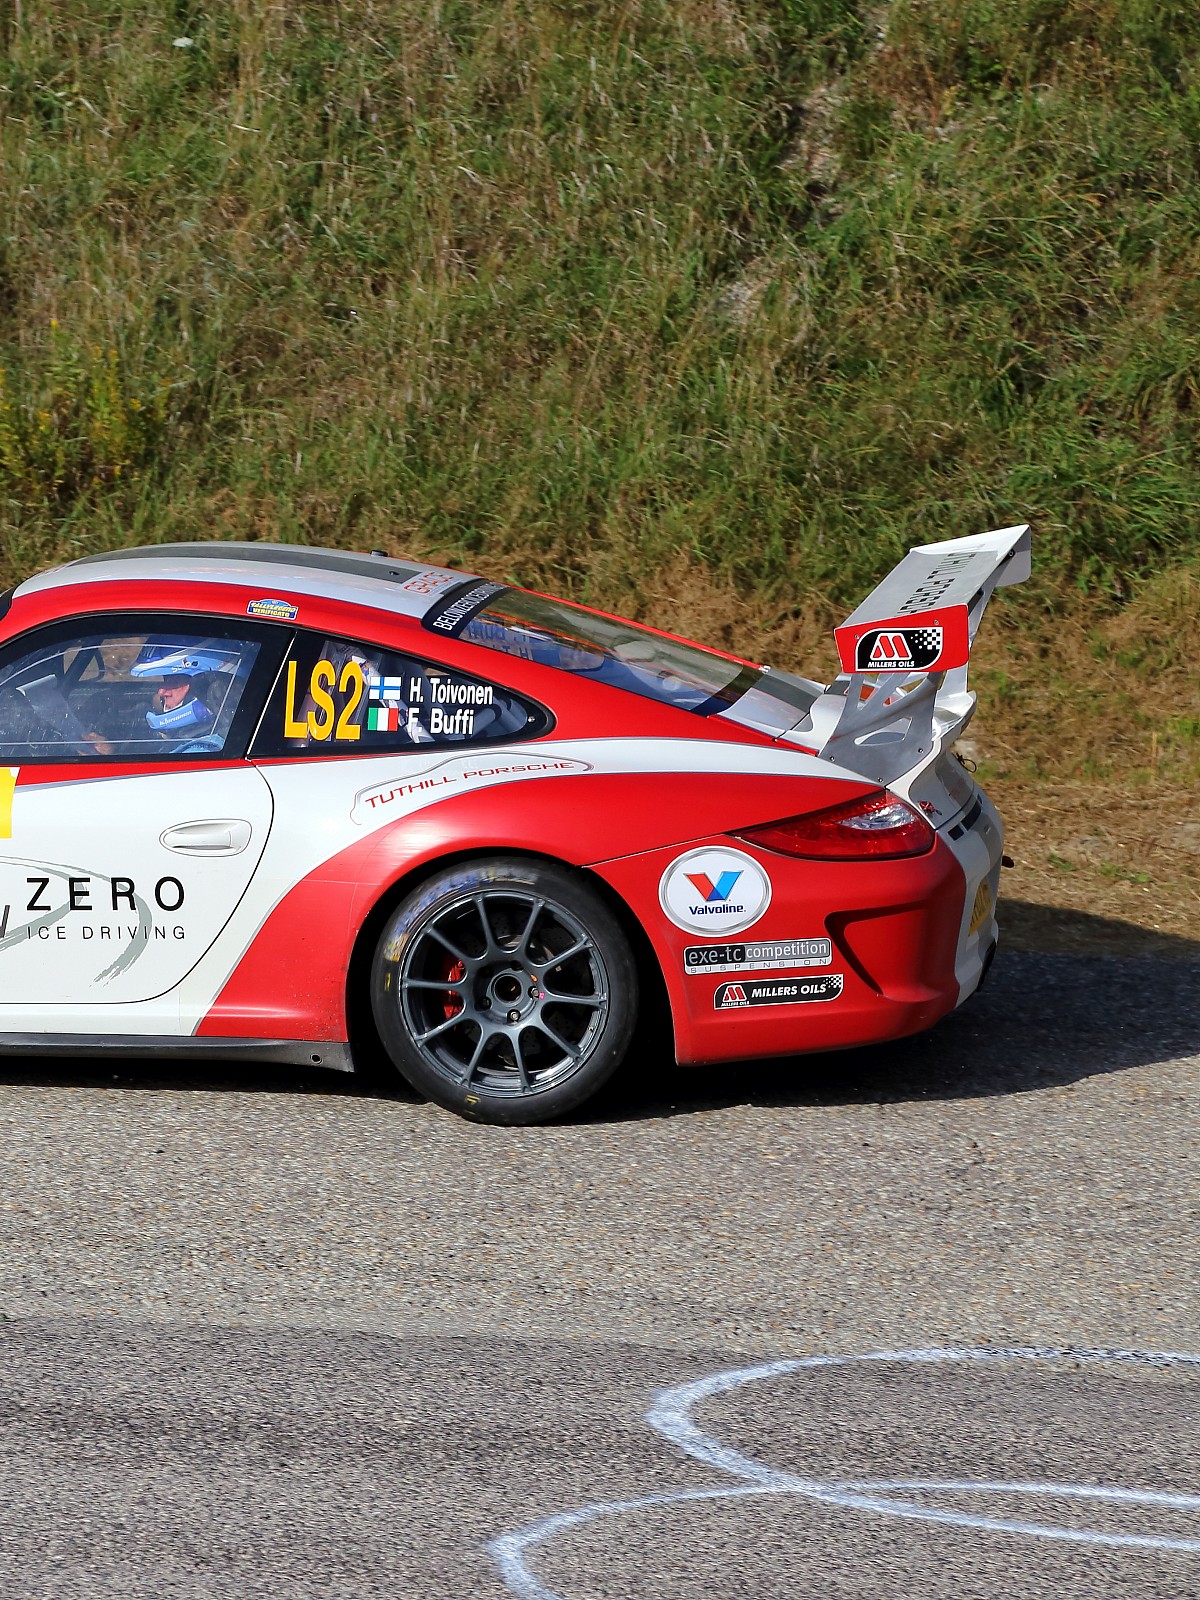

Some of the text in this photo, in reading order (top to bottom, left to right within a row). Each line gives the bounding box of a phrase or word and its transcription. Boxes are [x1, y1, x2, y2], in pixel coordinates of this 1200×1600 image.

[898, 660, 915, 668] OILS
[284, 659, 363, 741] LS2
[409, 677, 493, 705] H. Toivonen
[408, 707, 474, 735] F. Buffi
[364, 762, 574, 808] TUTHILL PORSCHE
[26, 876, 185, 912] ZERO
[689, 904, 744, 915] Valvoline
[27, 925, 186, 940] ICE DRIVING
[688, 941, 827, 965] exe-tc competition
[690, 958, 827, 973] SUSPENSION
[751, 984, 827, 998] MILLERS OILS
